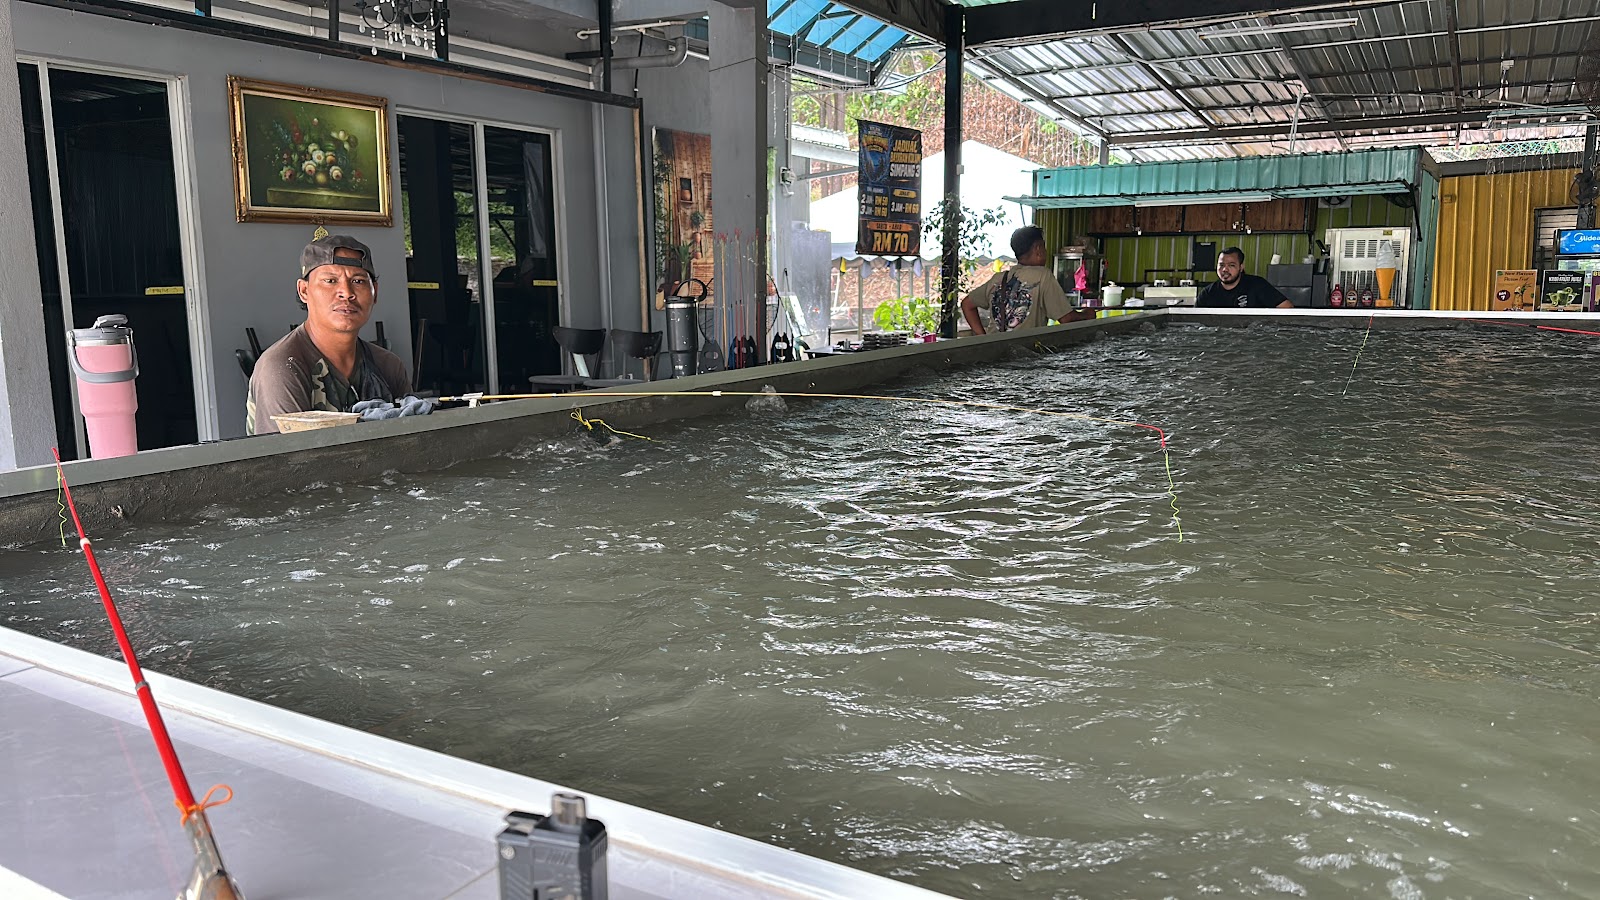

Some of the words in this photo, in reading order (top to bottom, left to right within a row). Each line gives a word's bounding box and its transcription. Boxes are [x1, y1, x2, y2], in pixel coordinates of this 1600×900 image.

[893, 140, 918, 152] JADUAL
[890, 164, 915, 176] SIMPANG
[915, 164, 920, 177] 3
[861, 194, 866, 204] 2
[860, 205, 865, 215] 3
[891, 202, 895, 212] 3
[872, 232, 892, 252] RM
[894, 233, 909, 252] 70
[1578, 234, 1600, 242] Midea
